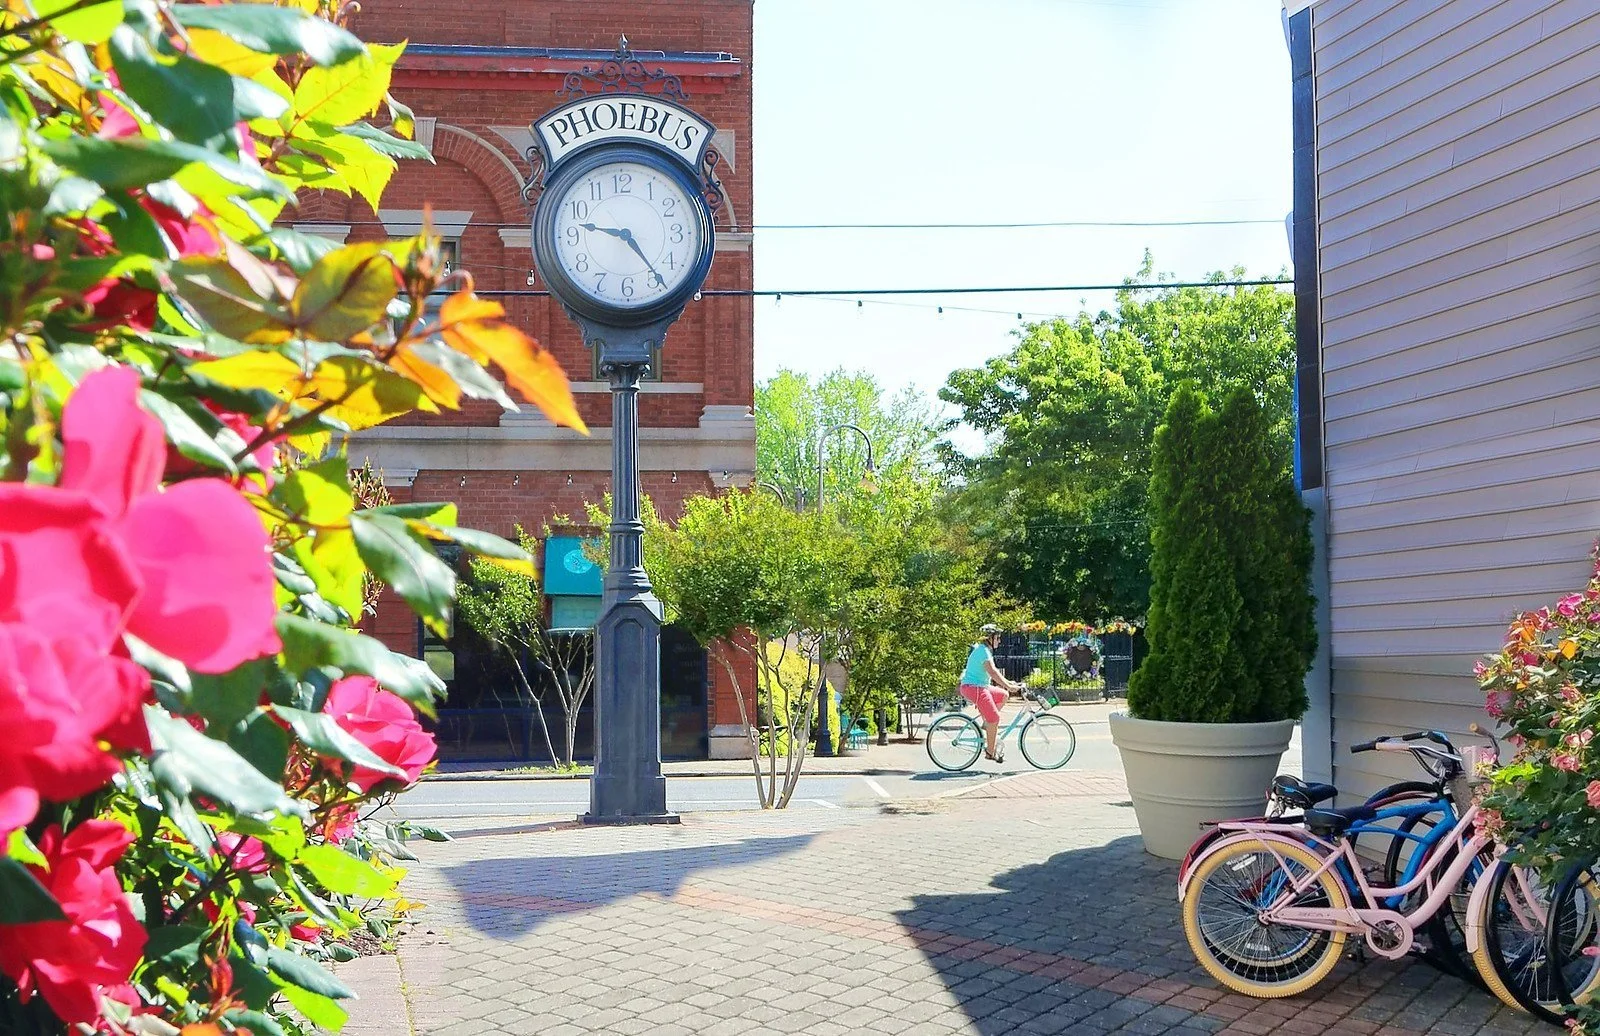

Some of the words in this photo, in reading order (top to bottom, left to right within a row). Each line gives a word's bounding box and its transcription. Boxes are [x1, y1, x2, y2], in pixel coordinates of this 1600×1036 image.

[548, 102, 699, 151] PHOEBUS
[589, 181, 603, 200] 11
[612, 173, 633, 194] 12
[646, 181, 653, 200] 1
[571, 199, 588, 219] 10
[662, 197, 675, 217] 2
[567, 226, 579, 246] 9
[670, 223, 684, 243] 3
[575, 252, 588, 272] 8
[662, 251, 677, 270] 4
[593, 272, 607, 292] 7
[621, 276, 634, 297] 6
[647, 270, 661, 289] 5
